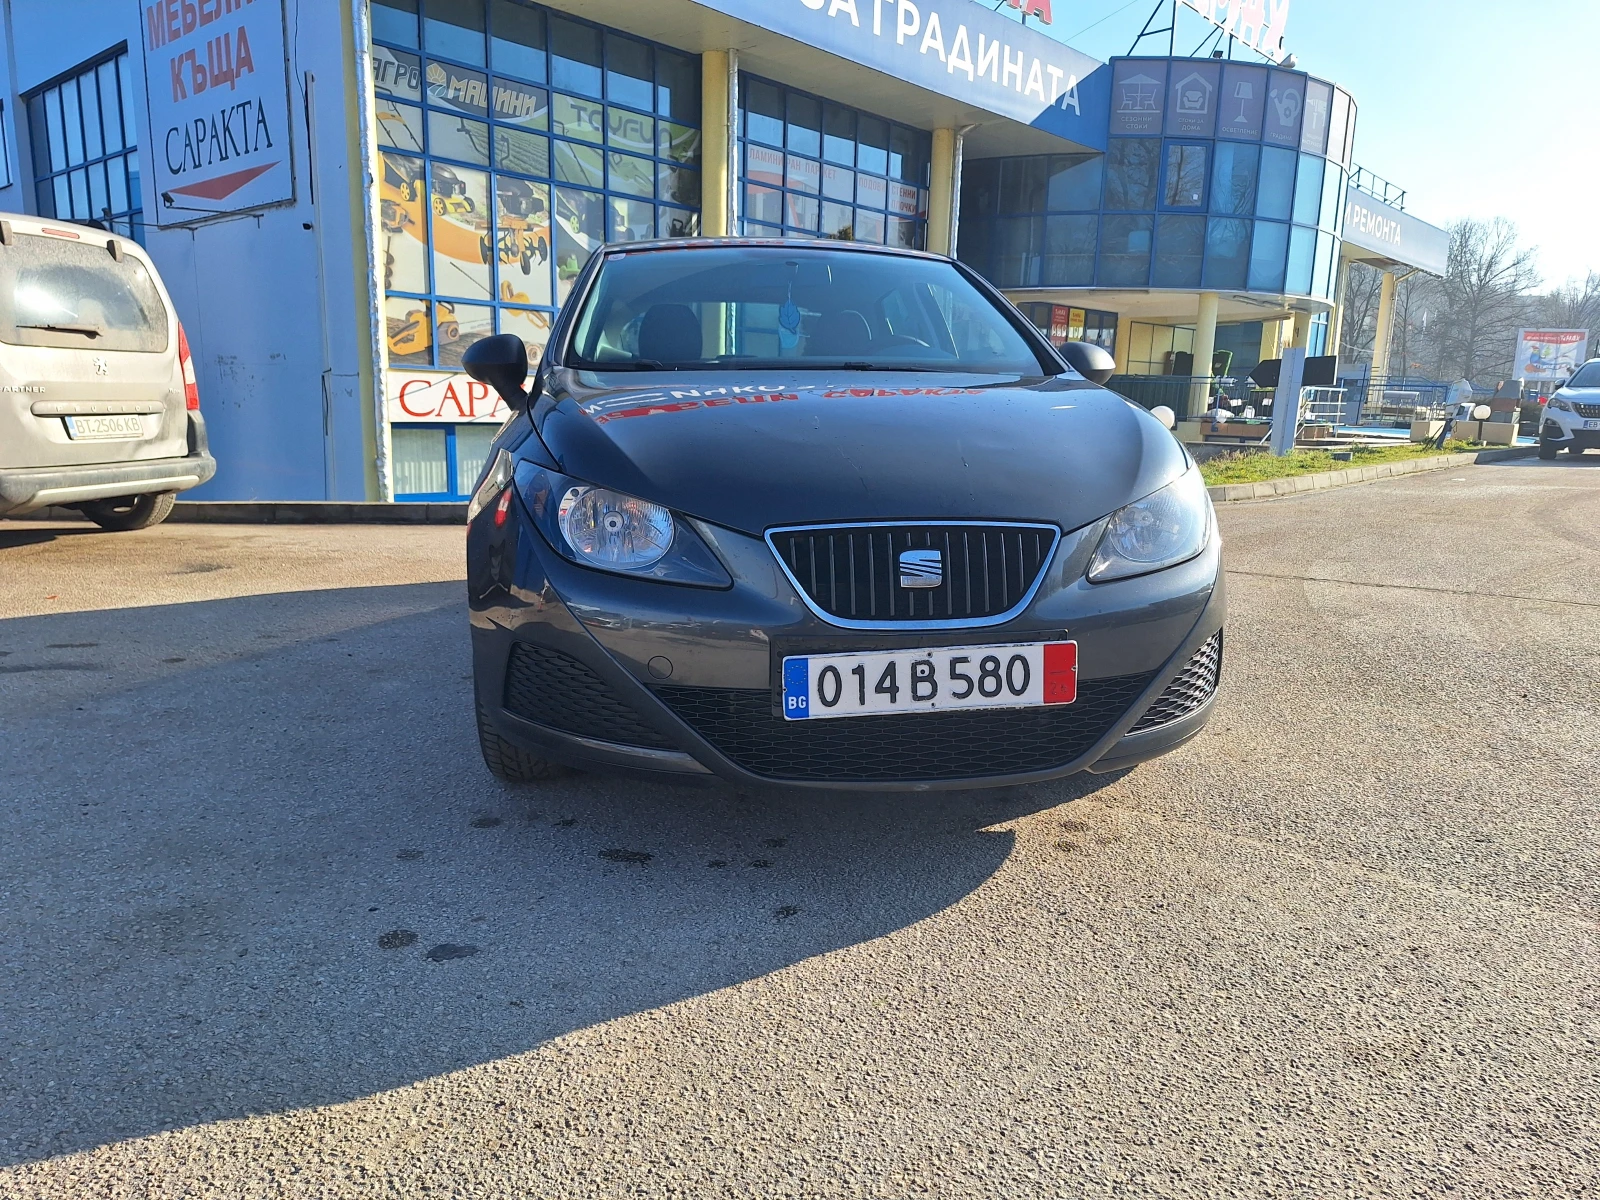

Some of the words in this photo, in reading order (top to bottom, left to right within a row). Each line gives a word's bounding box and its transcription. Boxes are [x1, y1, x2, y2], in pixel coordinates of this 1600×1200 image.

[170, 26, 254, 103] КЪЩА
[873, 0, 1081, 116] ГРАДИНАТА
[165, 97, 273, 175] САРАКТА
[1352, 204, 1401, 246] РЕМОНТА
[788, 696, 807, 709] BG
